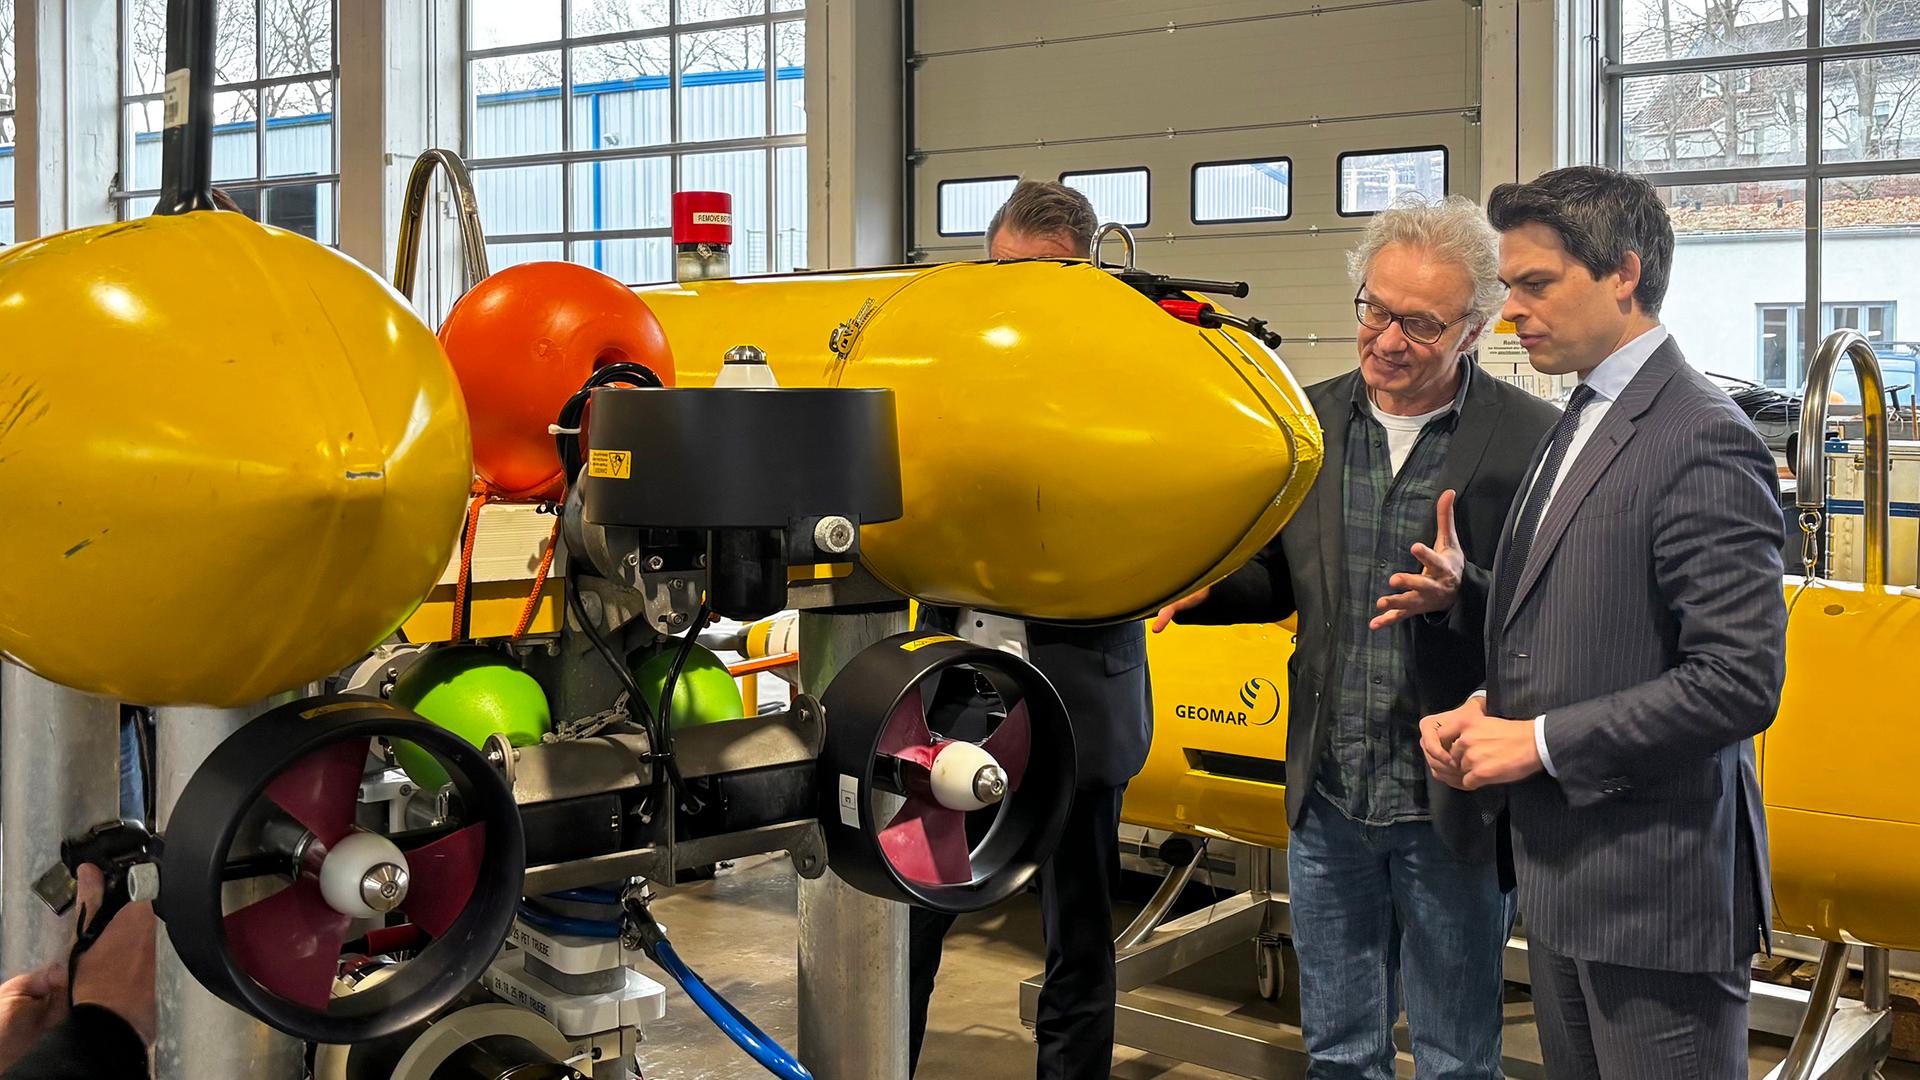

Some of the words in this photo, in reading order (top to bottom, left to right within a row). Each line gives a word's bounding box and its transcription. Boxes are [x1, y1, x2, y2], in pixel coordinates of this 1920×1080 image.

[698, 214, 720, 222] REMOVE
[1176, 704, 1248, 727] GEOMAR
[520, 932, 530, 945] PET
[518, 990, 527, 1005] PET
